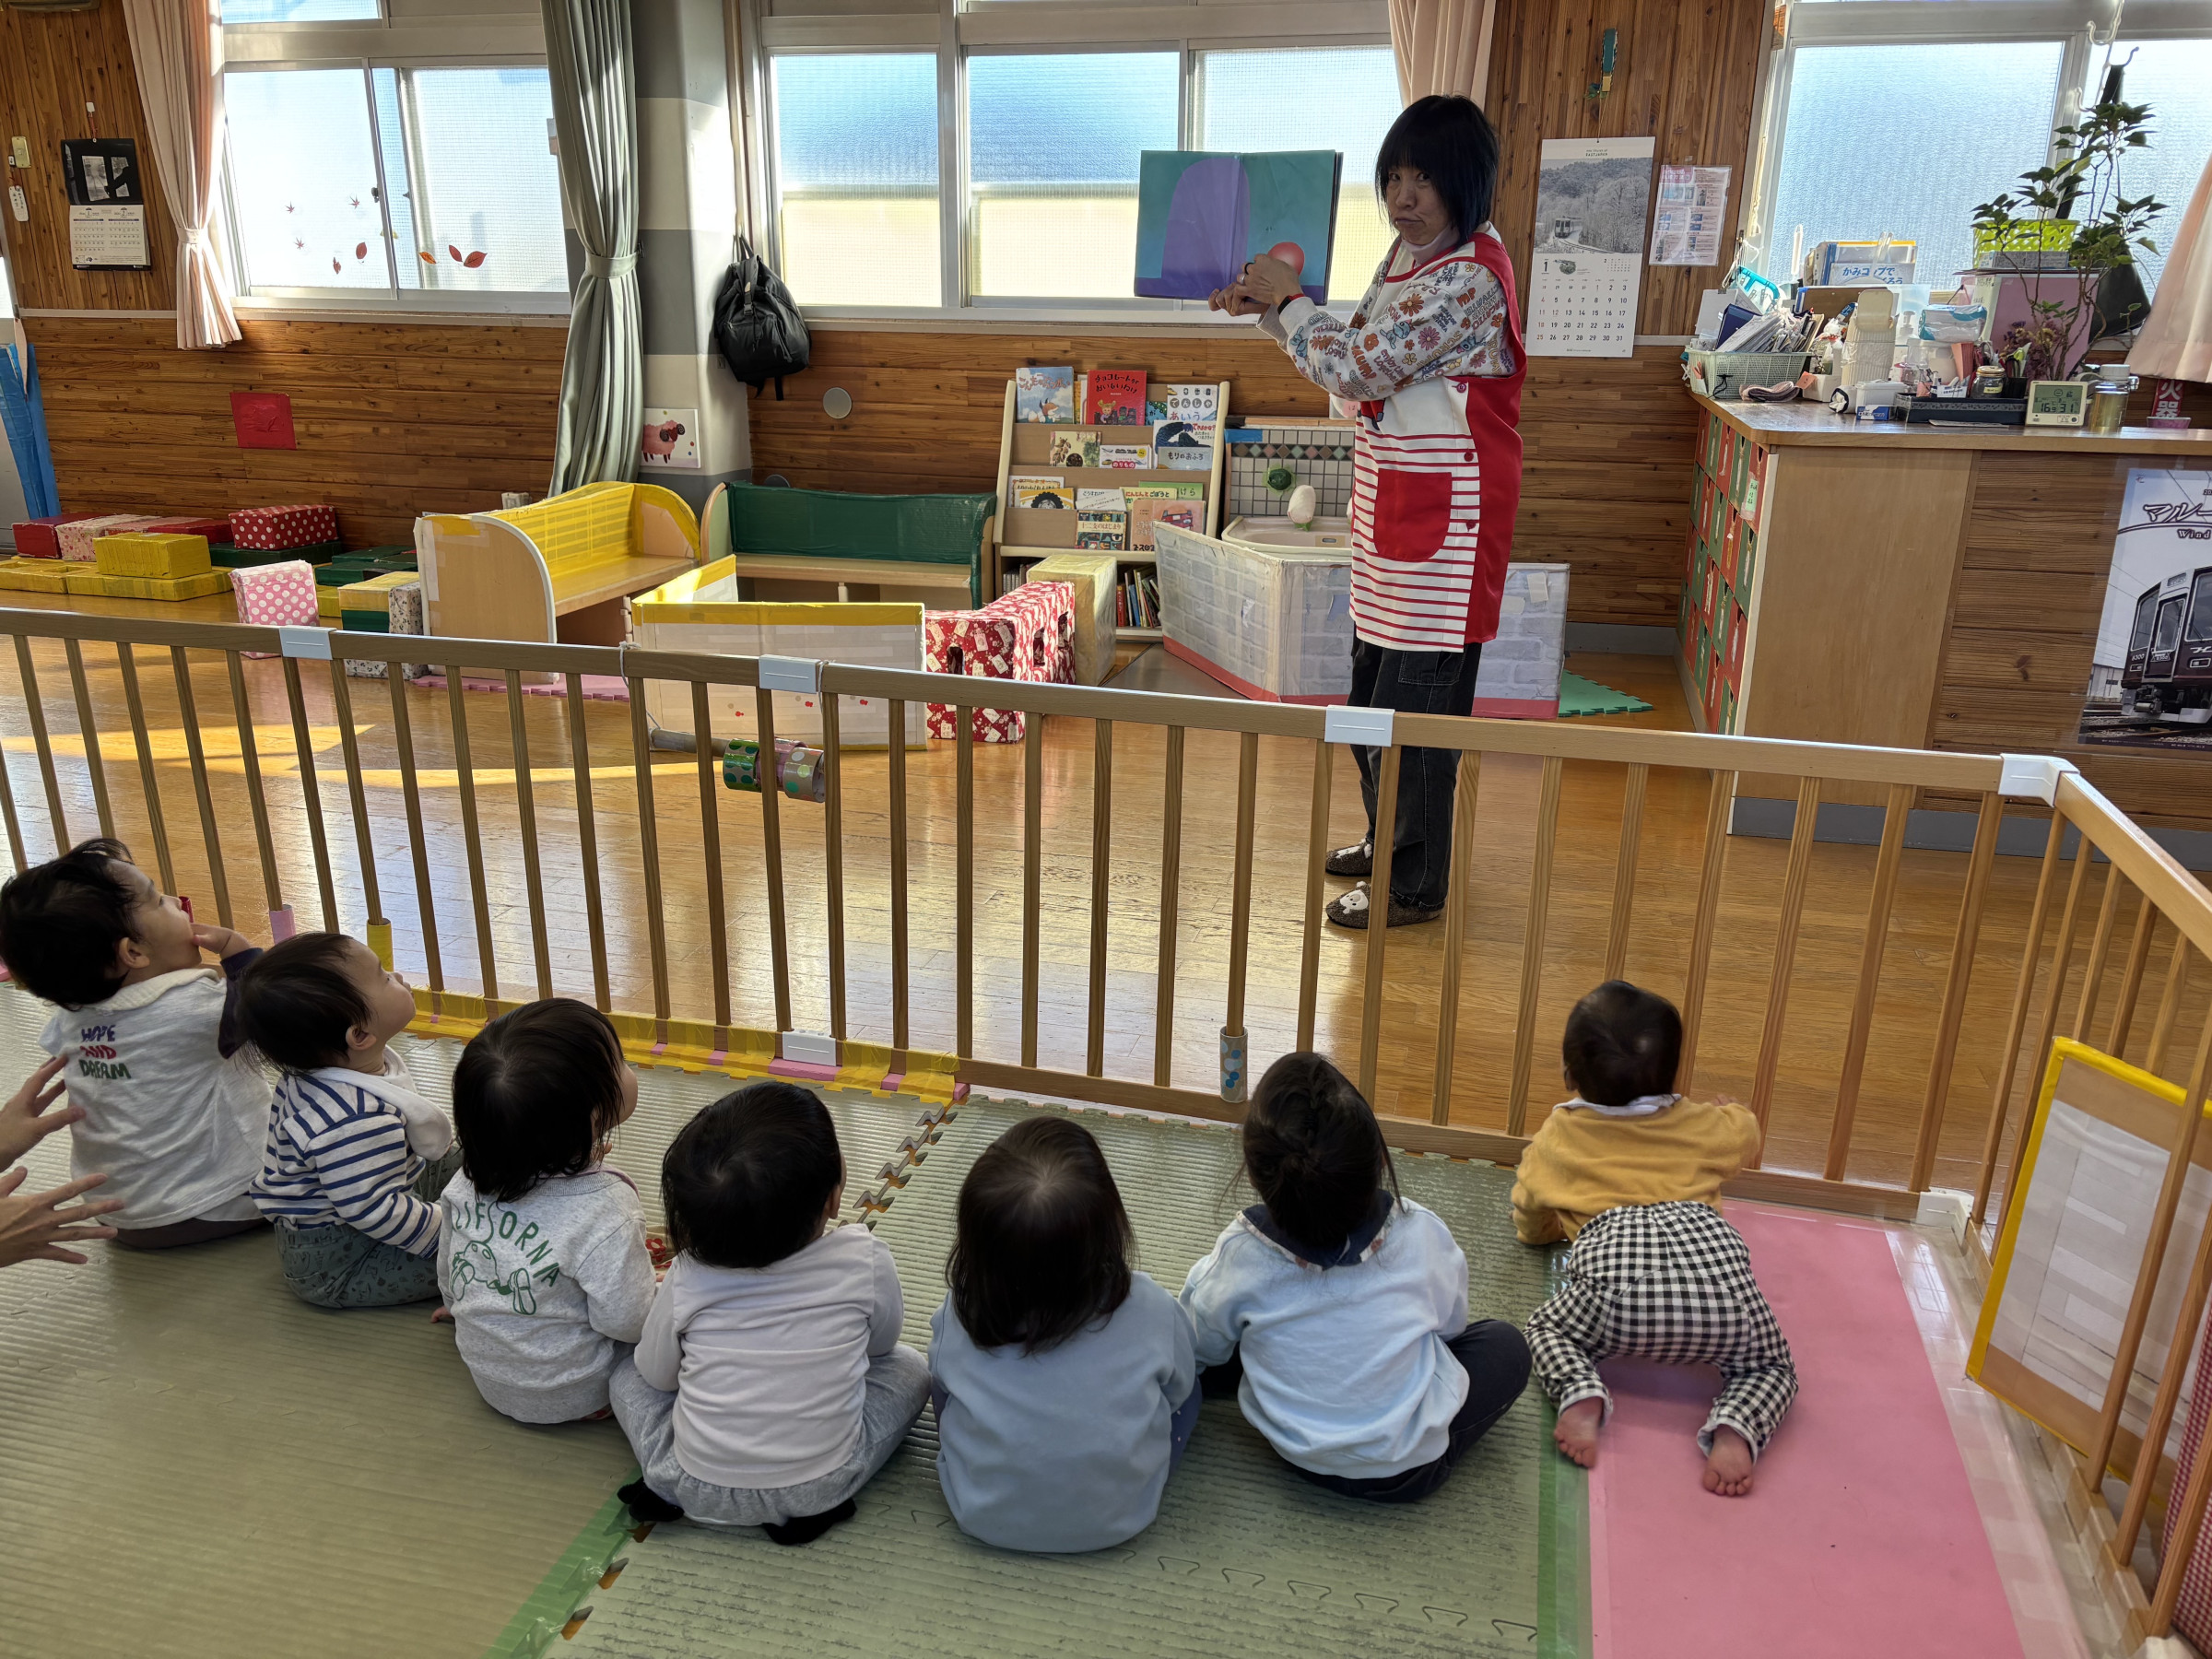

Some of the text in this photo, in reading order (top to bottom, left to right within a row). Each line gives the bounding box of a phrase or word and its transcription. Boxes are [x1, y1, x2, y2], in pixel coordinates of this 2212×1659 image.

[1842, 267, 1895, 276] かみコプで
[1095, 373, 1140, 384] チョコレートが
[2157, 380, 2183, 418] 火器
[1168, 452, 1204, 460] もりのおふろ
[2177, 529, 2211, 539] Wind
[81, 1025, 116, 1041] HOPE
[78, 1059, 132, 1079] DREAM
